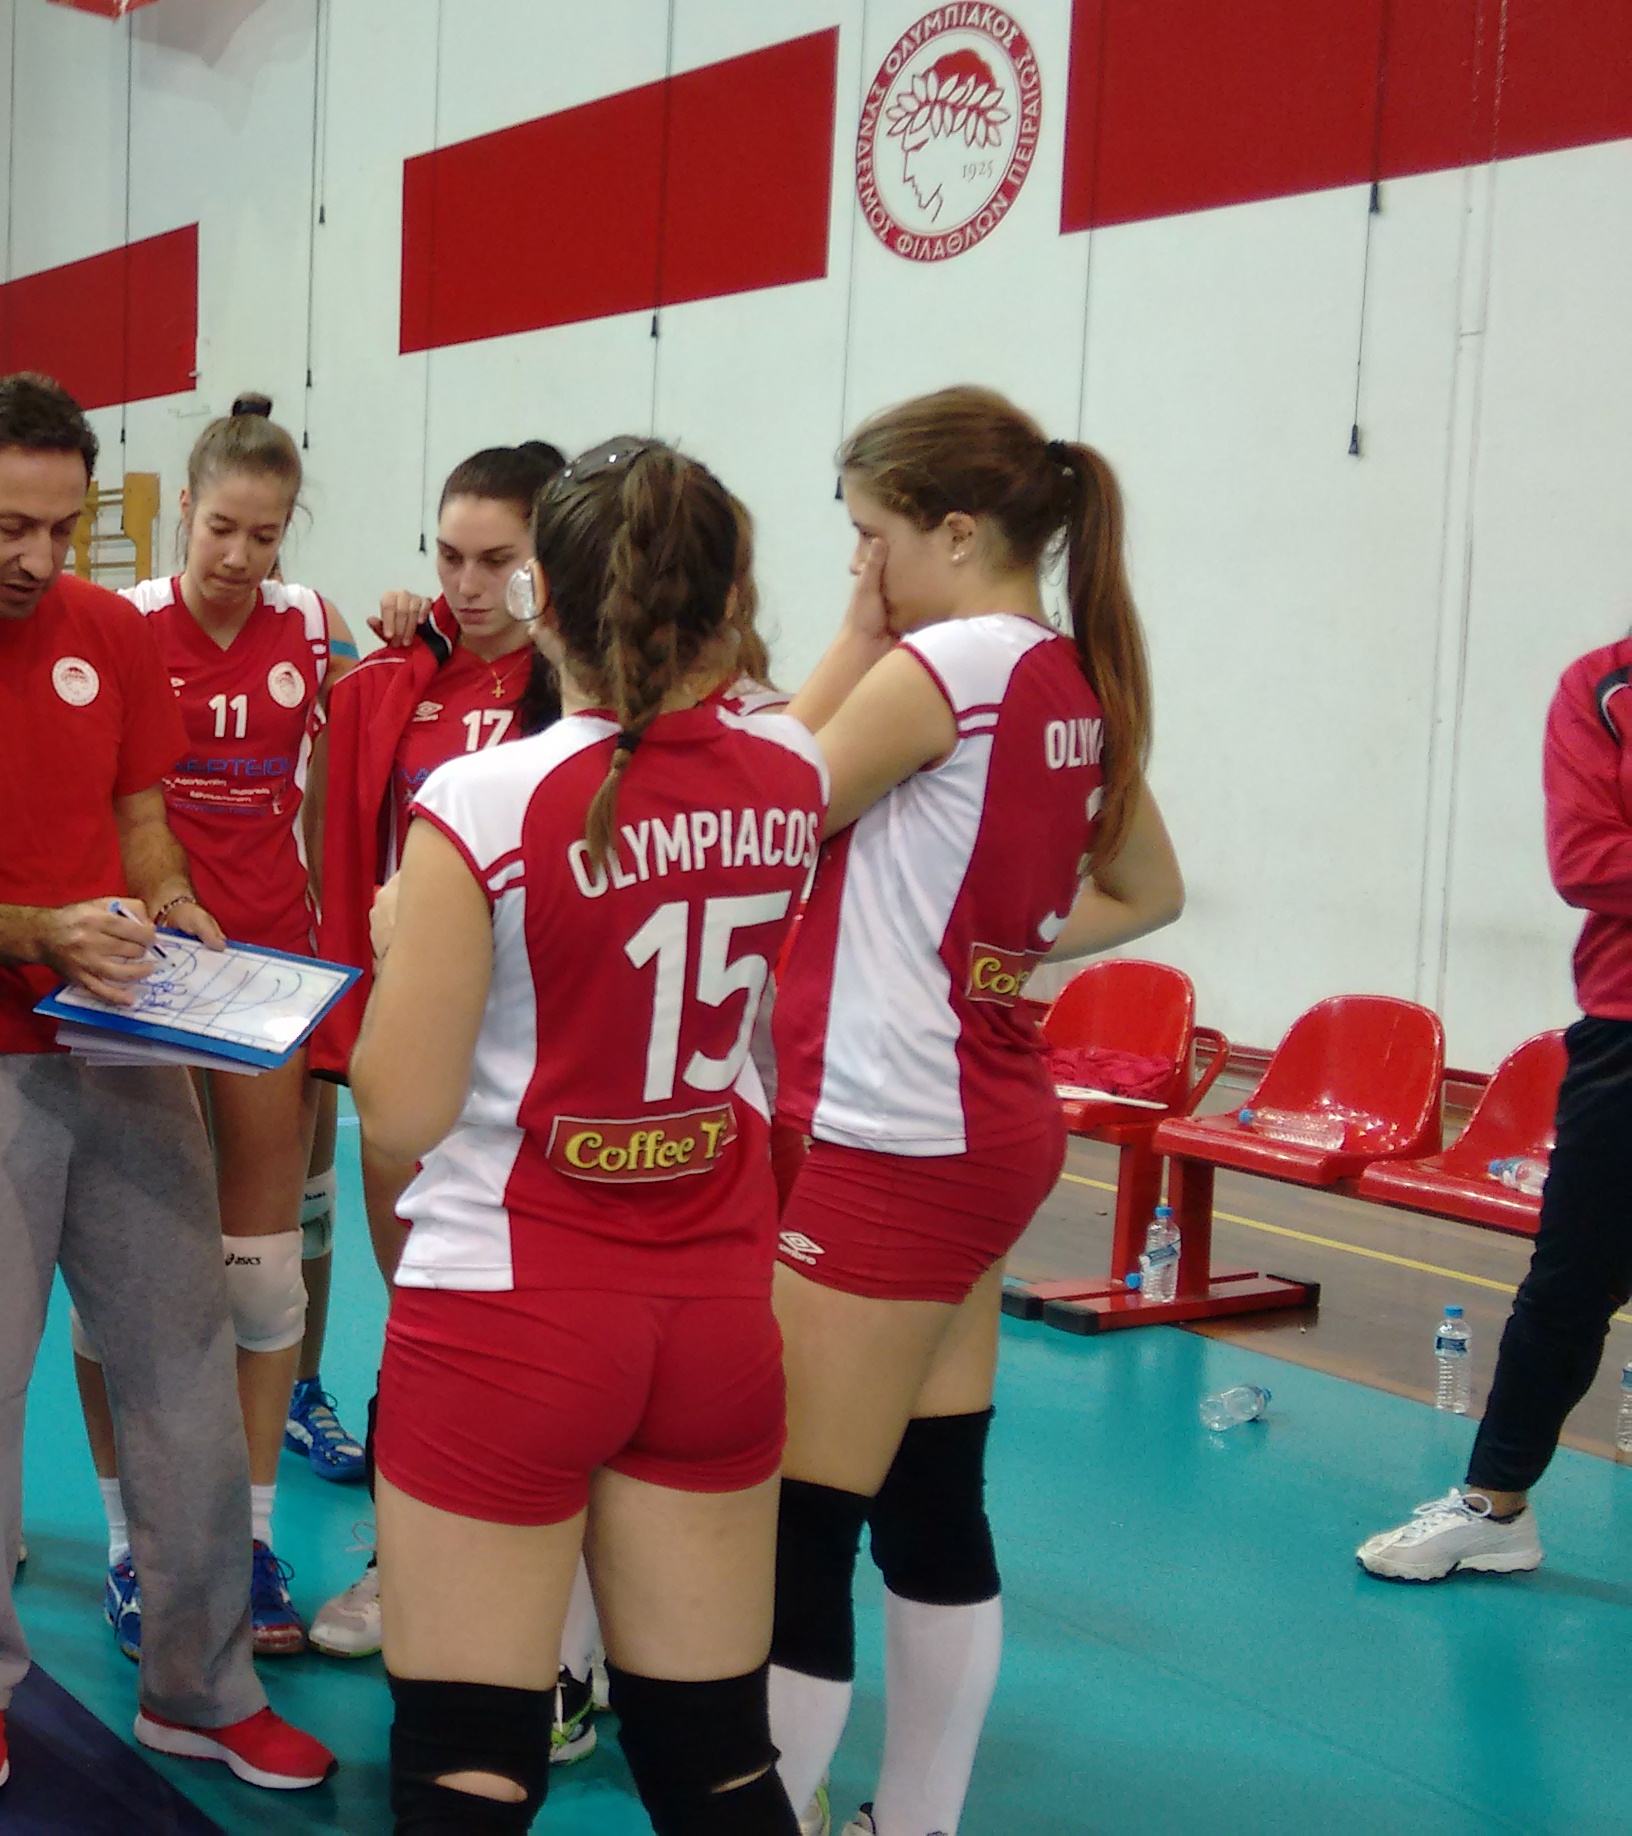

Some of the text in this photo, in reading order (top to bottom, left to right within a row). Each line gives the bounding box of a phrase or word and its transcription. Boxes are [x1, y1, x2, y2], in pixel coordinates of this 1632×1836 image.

[886, 4, 1019, 74] ΟΛΥΜΠΙΑΚΟΣ
[896, 50, 1040, 260] ΦΙΛΑΘΛΩΝ ΠΕΙΡΑΙΩΣ
[961, 160, 995, 182] 1925
[208, 694, 248, 738] 11
[461, 708, 514, 752] 17
[568, 808, 818, 898] OLYMPIACOS
[624, 890, 792, 1102] 15
[564, 1114, 726, 1172] Coffee T
